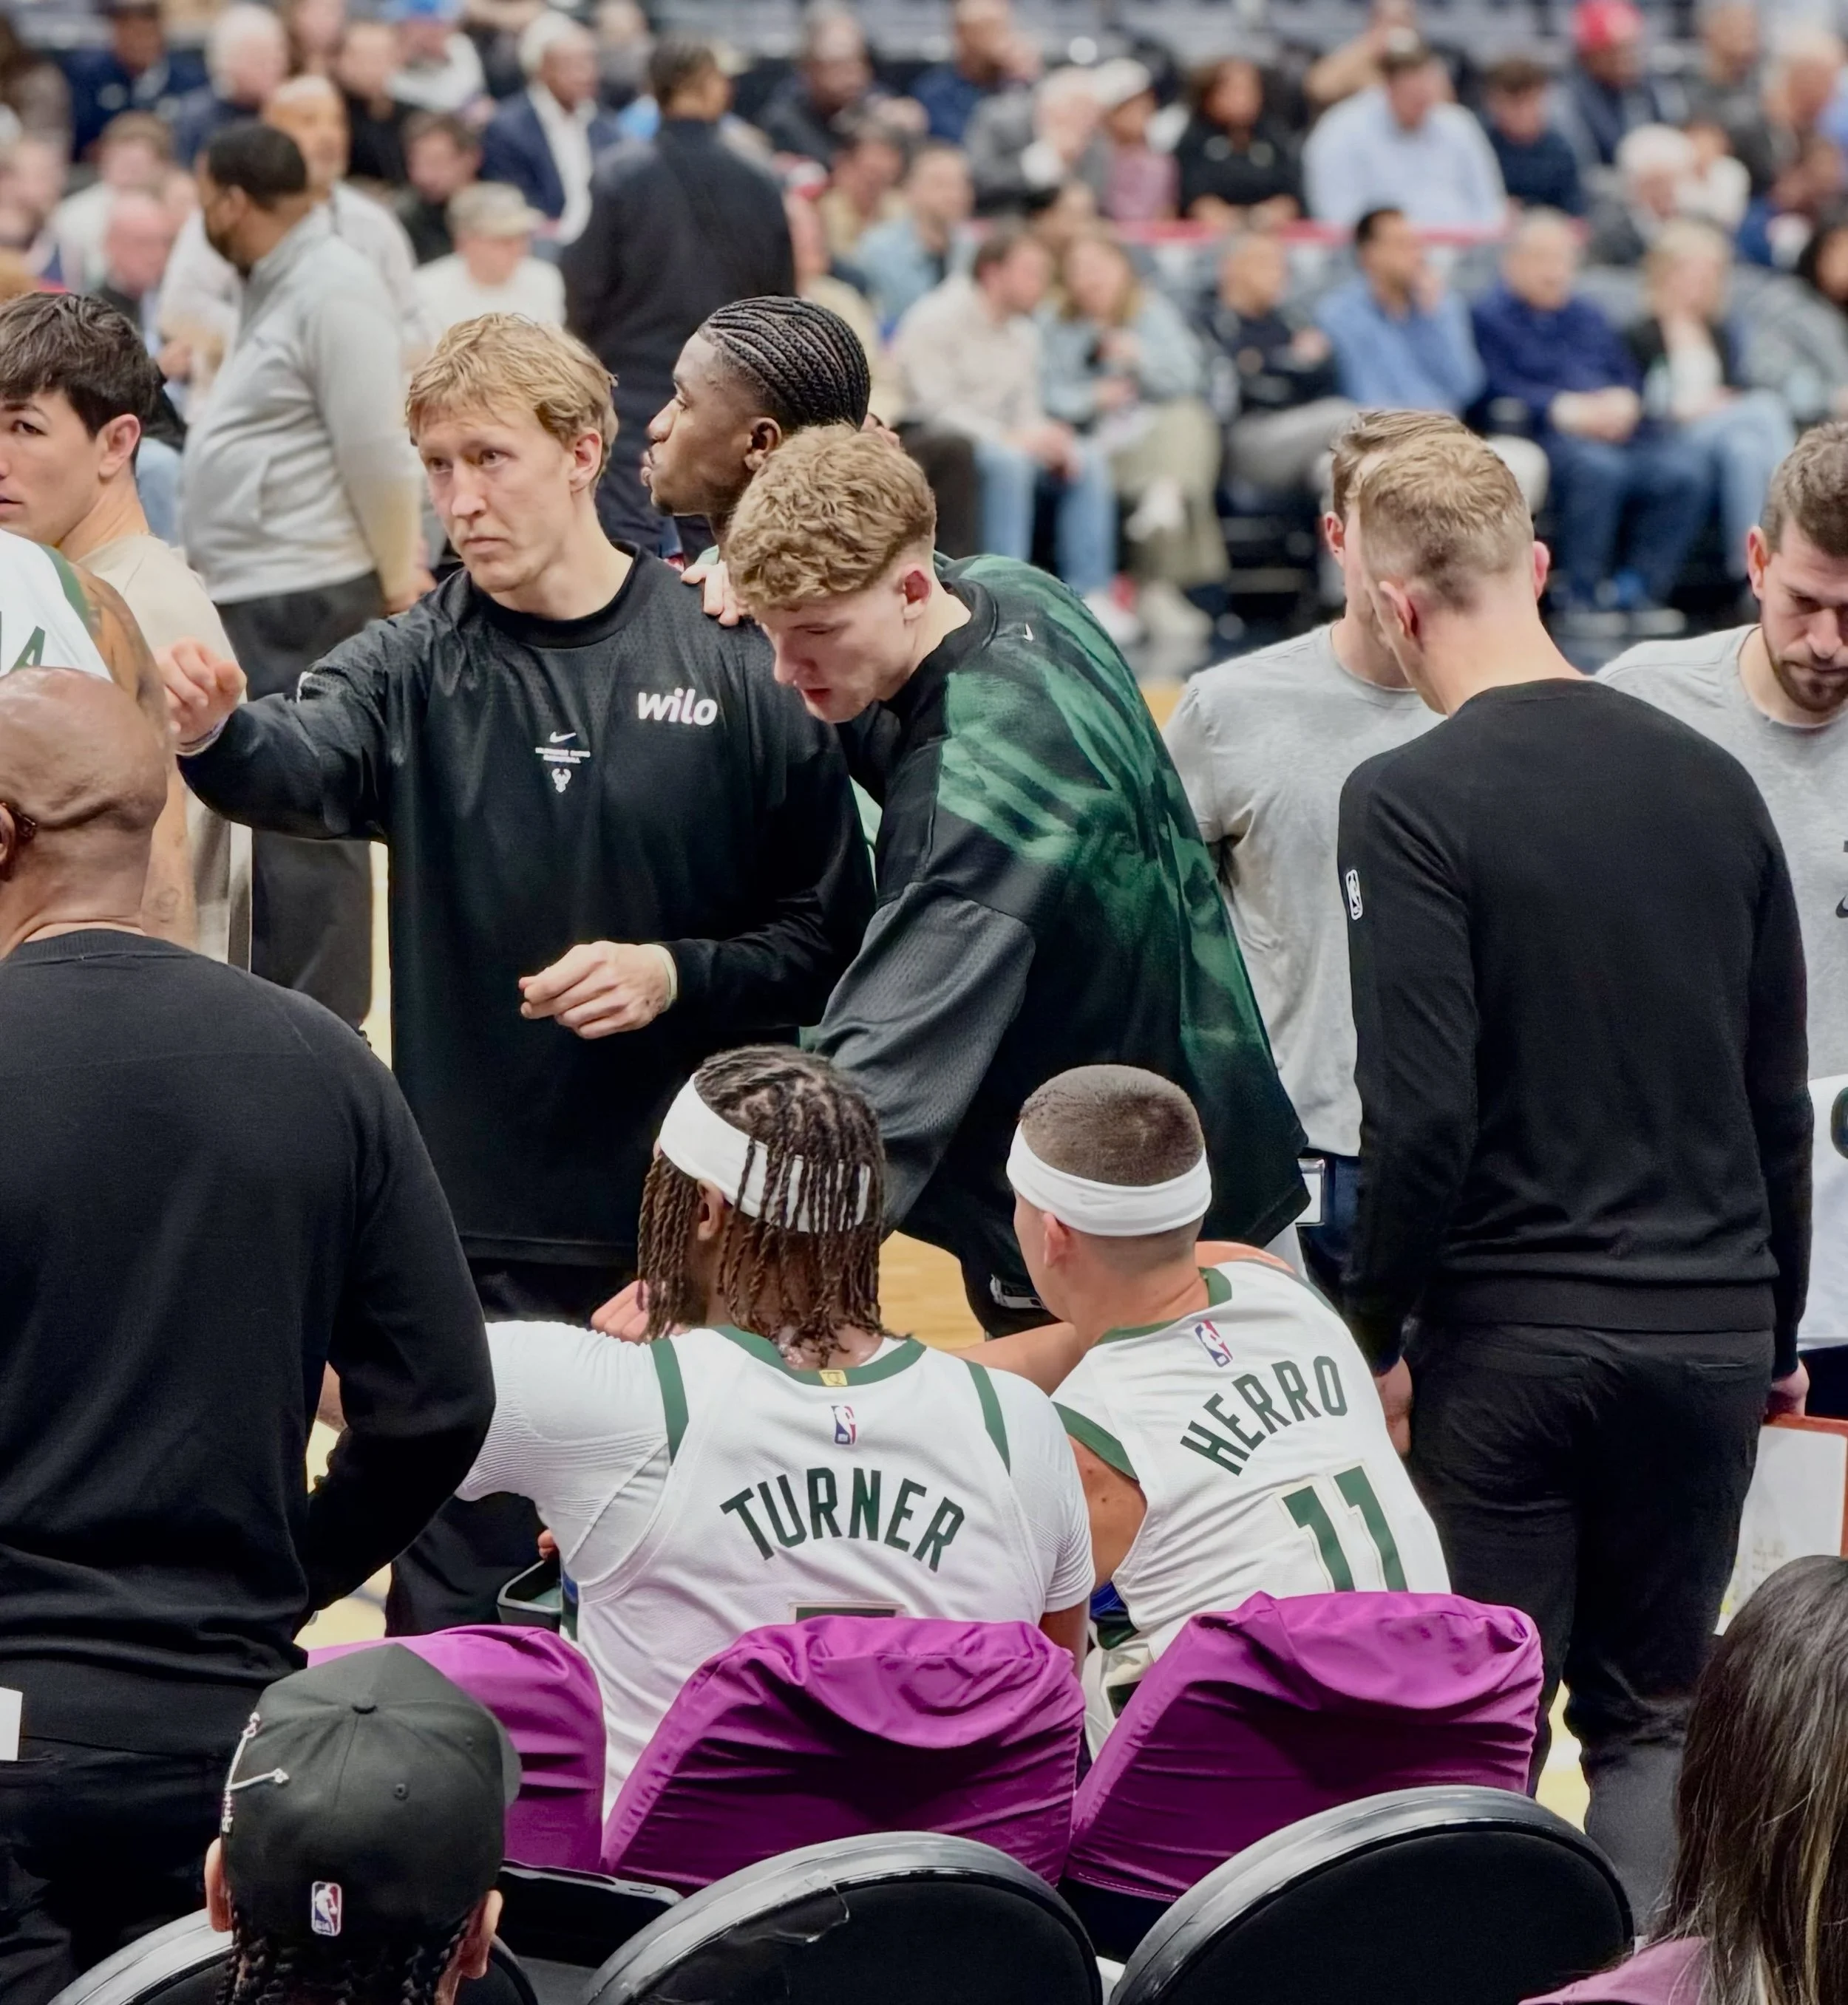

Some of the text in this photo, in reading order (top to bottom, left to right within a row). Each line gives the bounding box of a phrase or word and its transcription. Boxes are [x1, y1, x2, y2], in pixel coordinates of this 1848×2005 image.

[637, 687, 719, 726] wilo
[1180, 1355, 1348, 1477] HERRO
[719, 1467, 965, 1573] TURNER
[1280, 1464, 1409, 1593] 11
